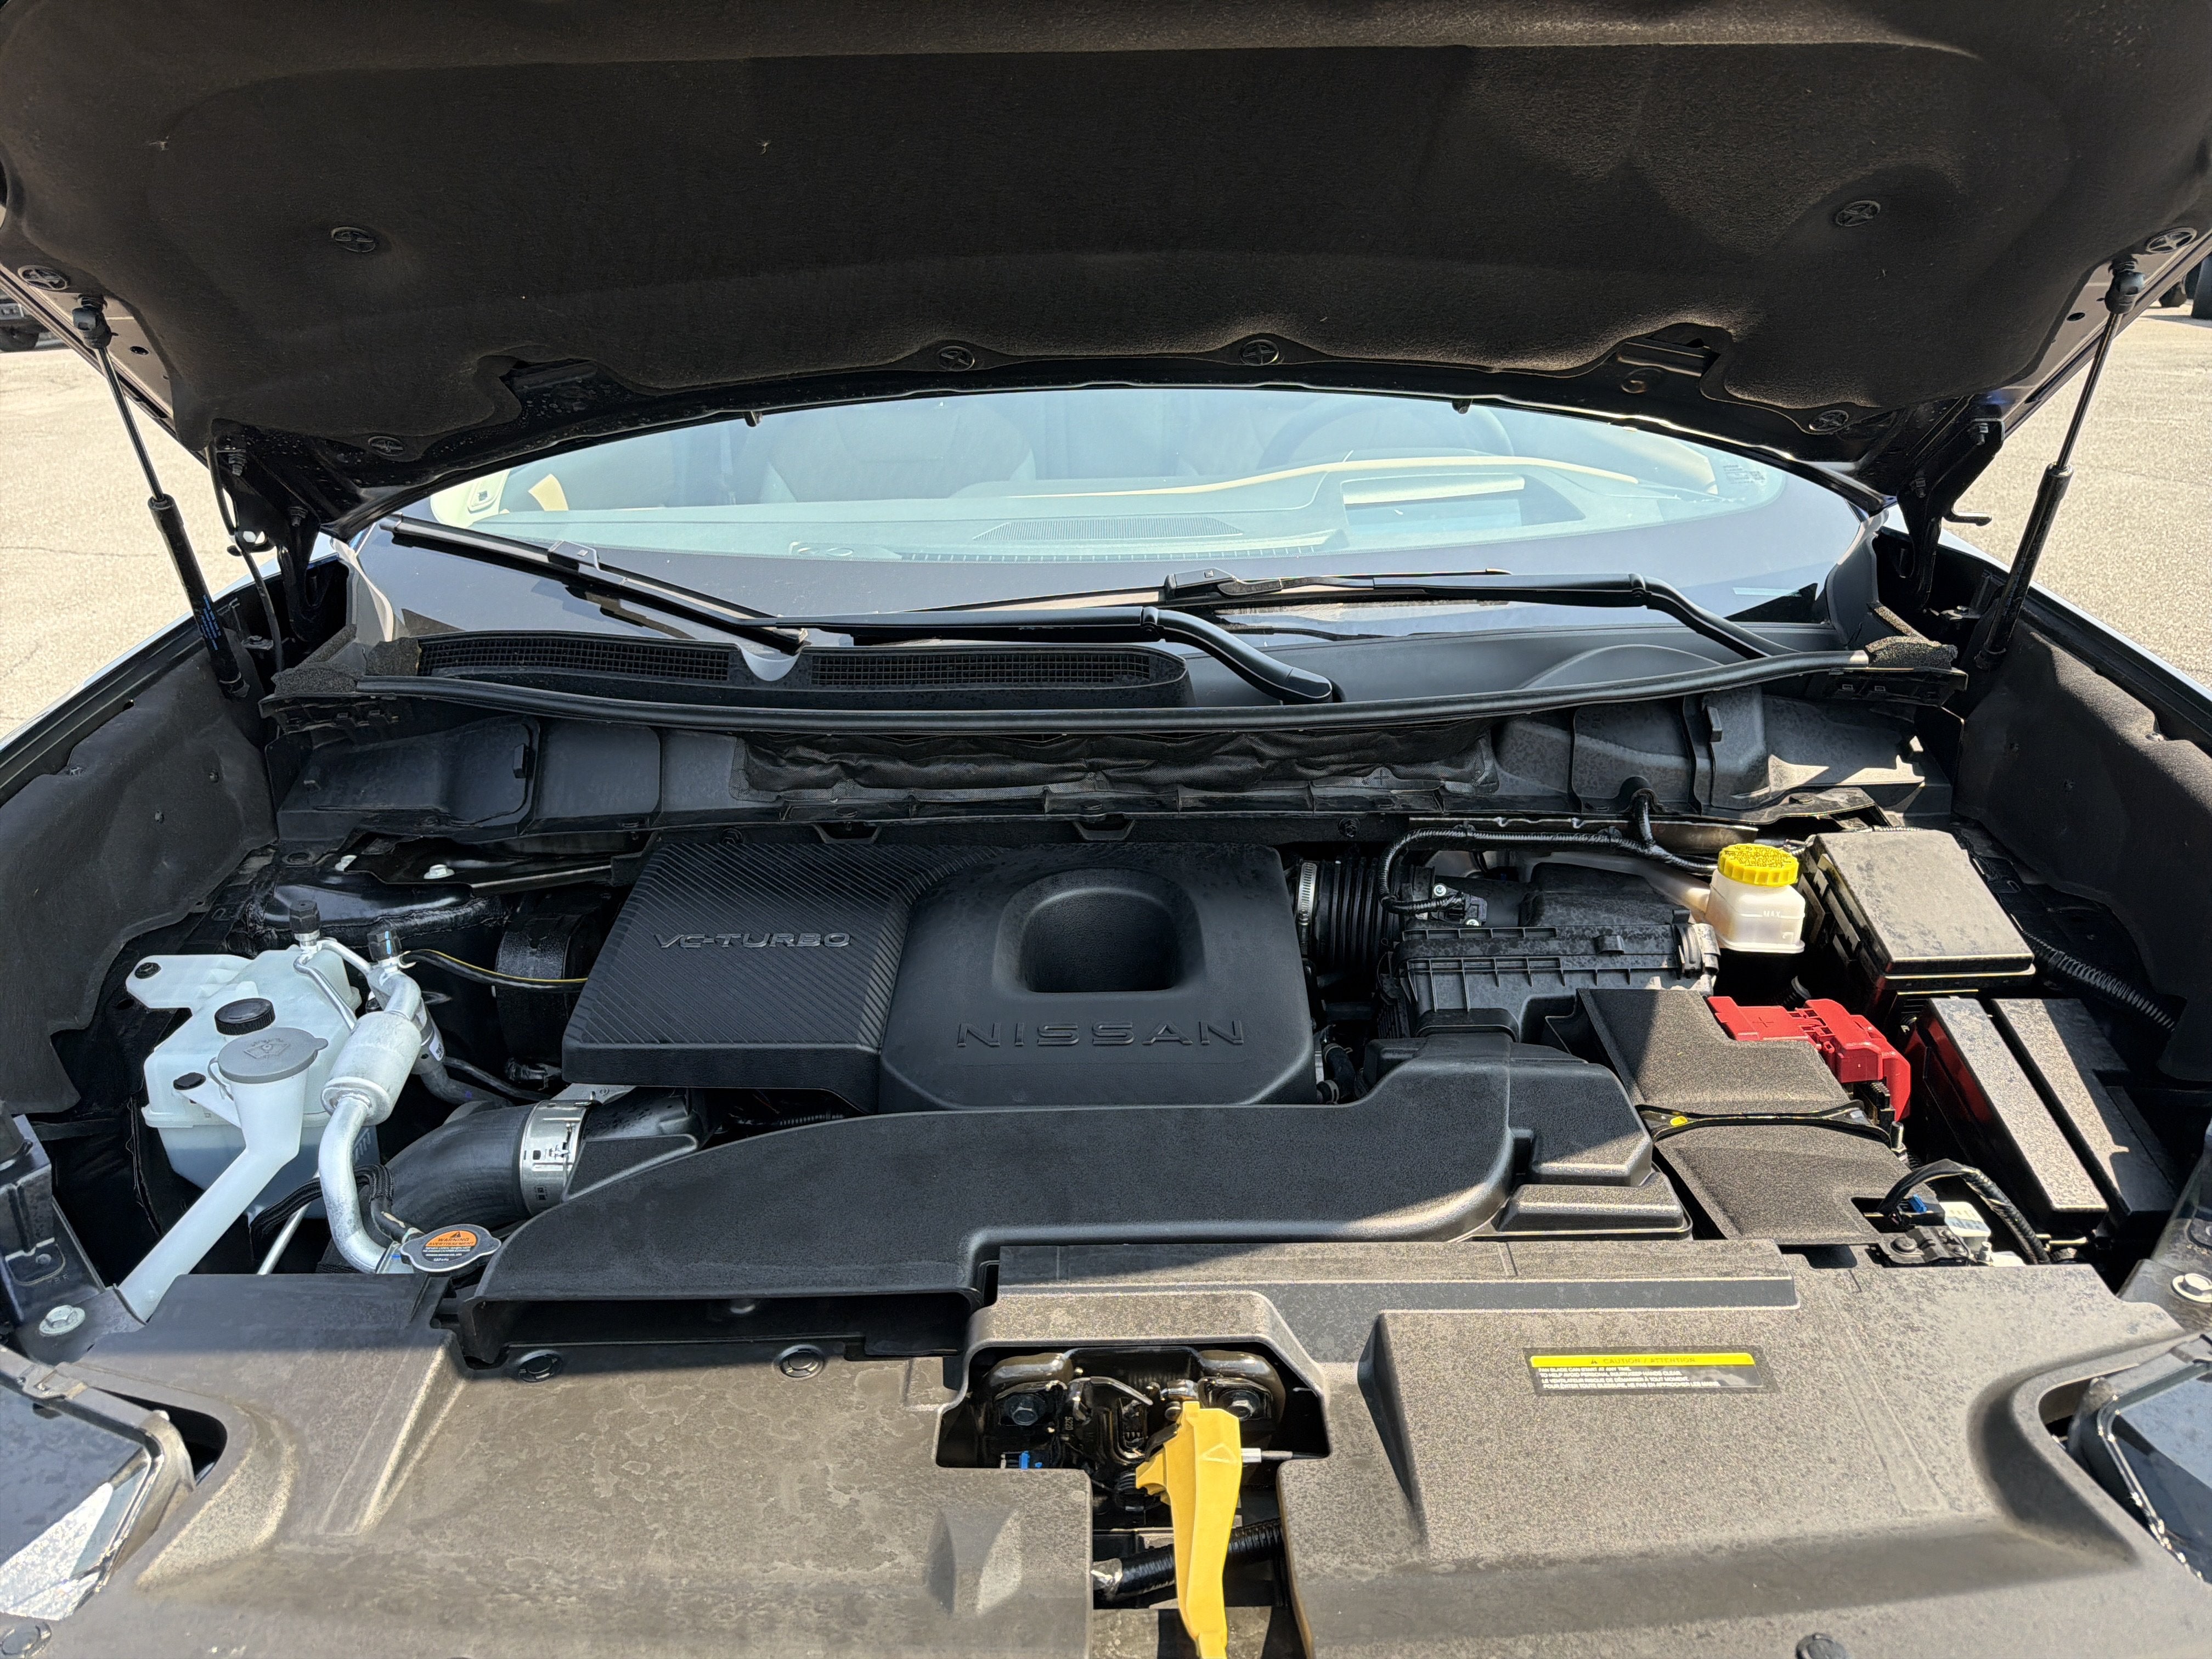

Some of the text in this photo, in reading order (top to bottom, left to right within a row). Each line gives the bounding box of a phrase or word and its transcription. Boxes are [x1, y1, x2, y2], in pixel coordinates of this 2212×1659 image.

[654, 932, 851, 949] VC-TURBO
[957, 1020, 1244, 1047] NISSAN
[1065, 1416, 1074, 1431] 5220
